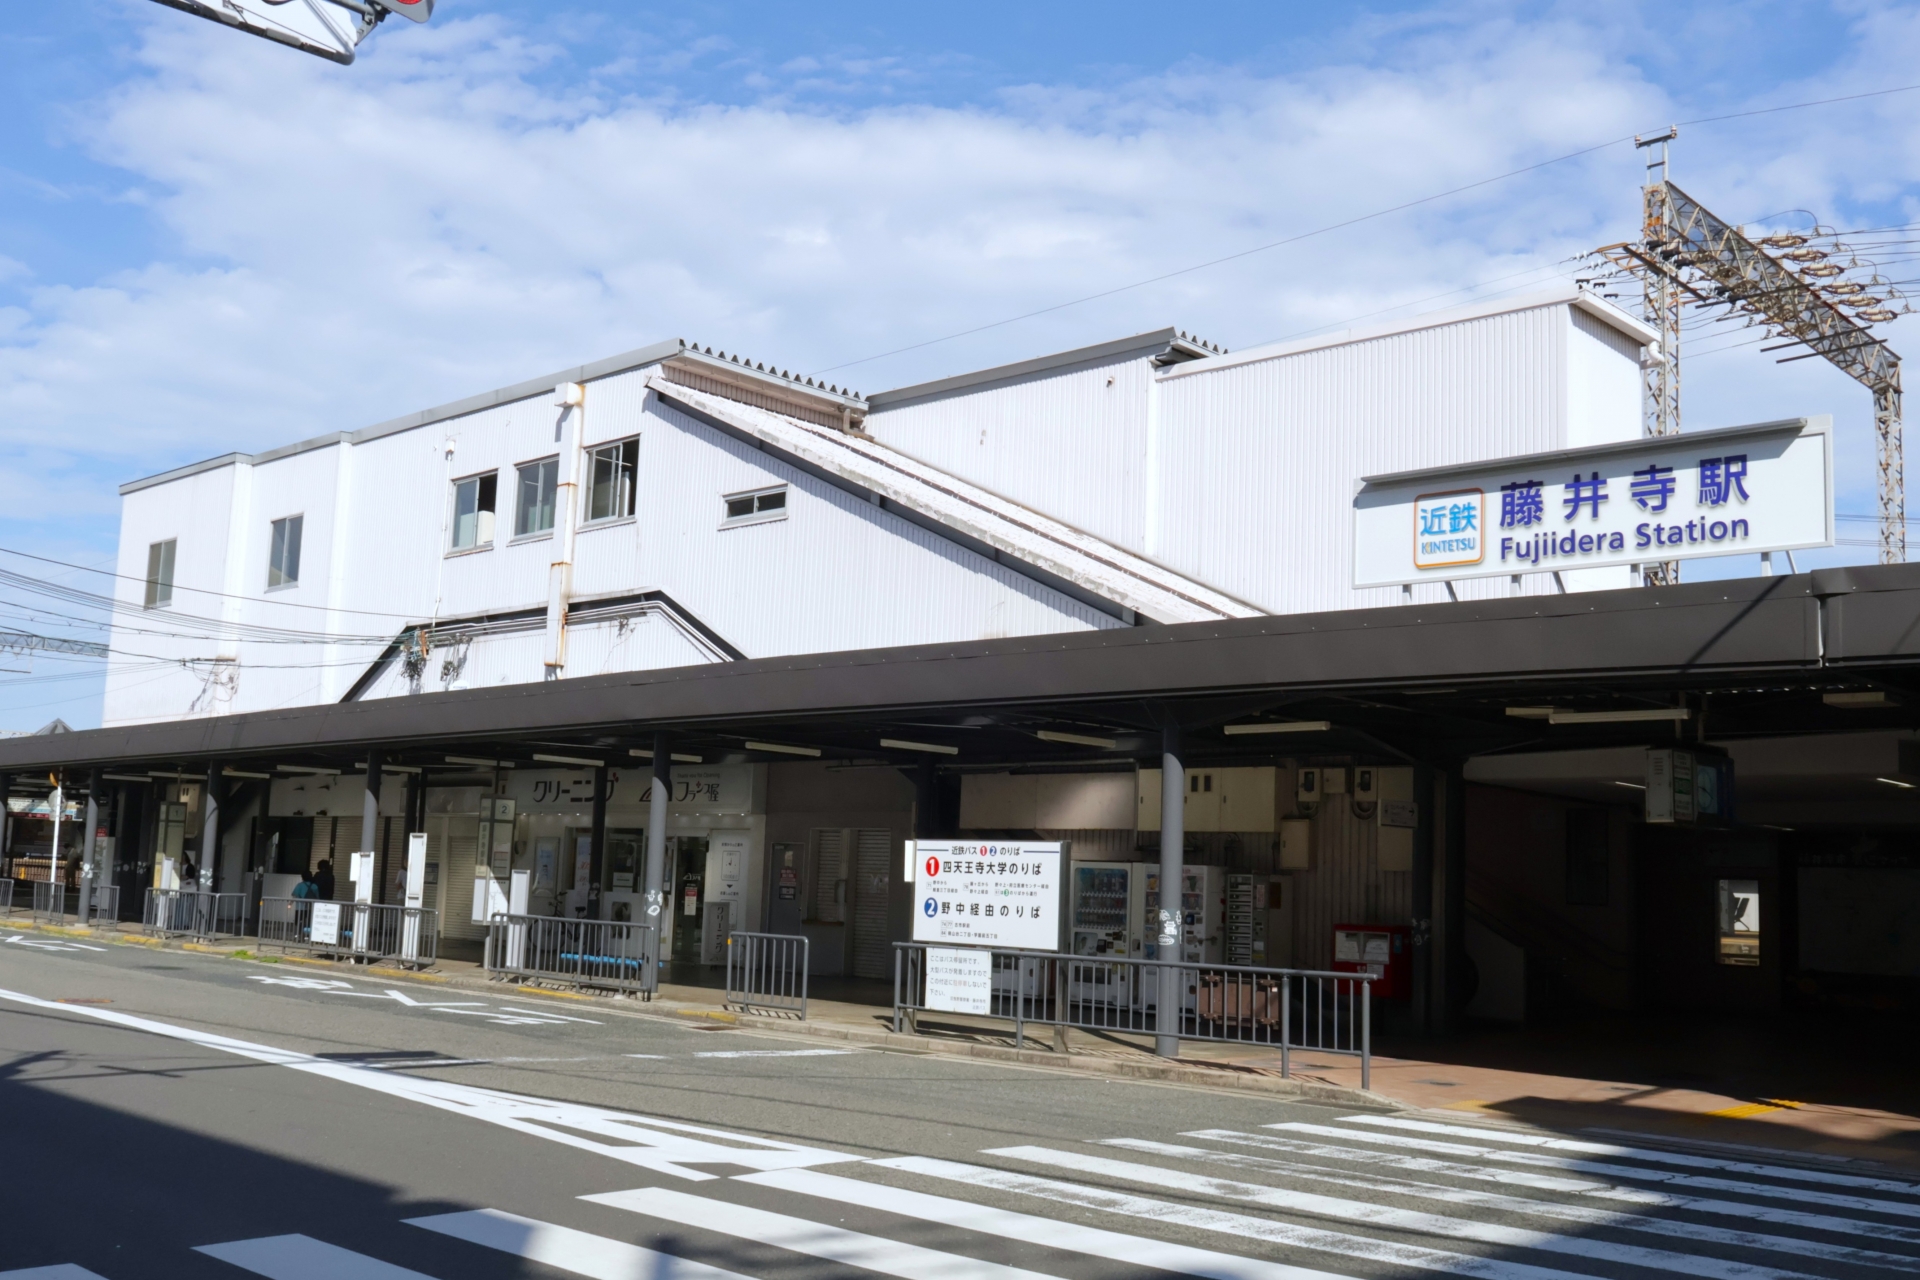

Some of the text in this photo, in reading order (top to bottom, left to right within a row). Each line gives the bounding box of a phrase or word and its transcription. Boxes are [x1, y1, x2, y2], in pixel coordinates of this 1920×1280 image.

[1499, 453, 1751, 529] 藤井寺駅
[1420, 502, 1478, 538] 近鉄
[1421, 536, 1476, 556] KINTETSU
[1500, 515, 1750, 565] Fujiidera Station
[951, 846, 978, 856] 近鉄バス
[1000, 846, 1021, 856] のりば
[943, 861, 1042, 876] 四天王寺大学のりば
[941, 902, 1041, 919] 野中経由のりば
